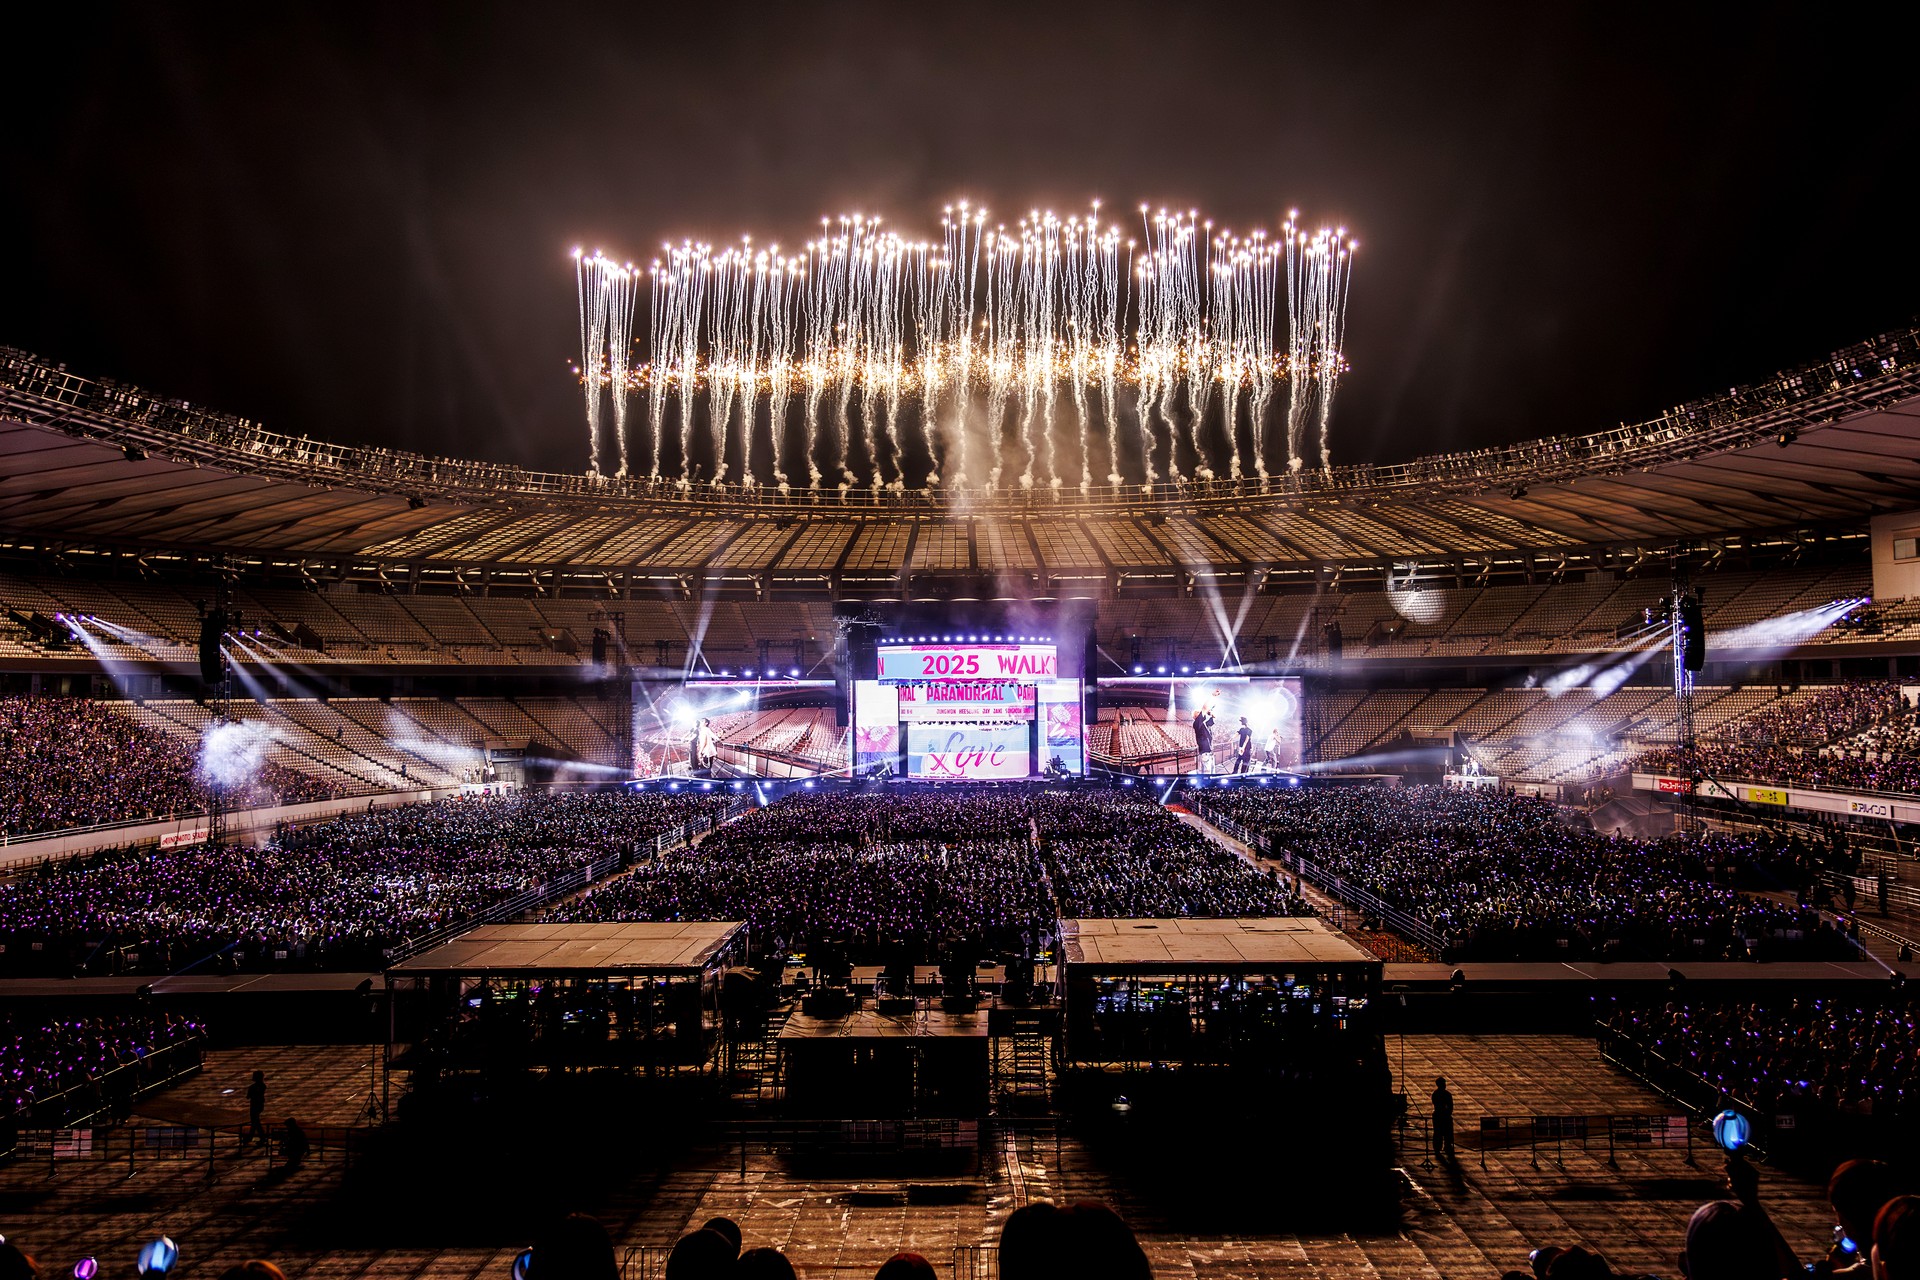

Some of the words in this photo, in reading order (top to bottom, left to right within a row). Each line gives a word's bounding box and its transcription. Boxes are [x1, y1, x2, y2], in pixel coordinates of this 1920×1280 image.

[922, 655, 980, 675] 2025
[926, 685, 1004, 701] PARANORMAL
[1857, 802, 1887, 816] アルインコ
